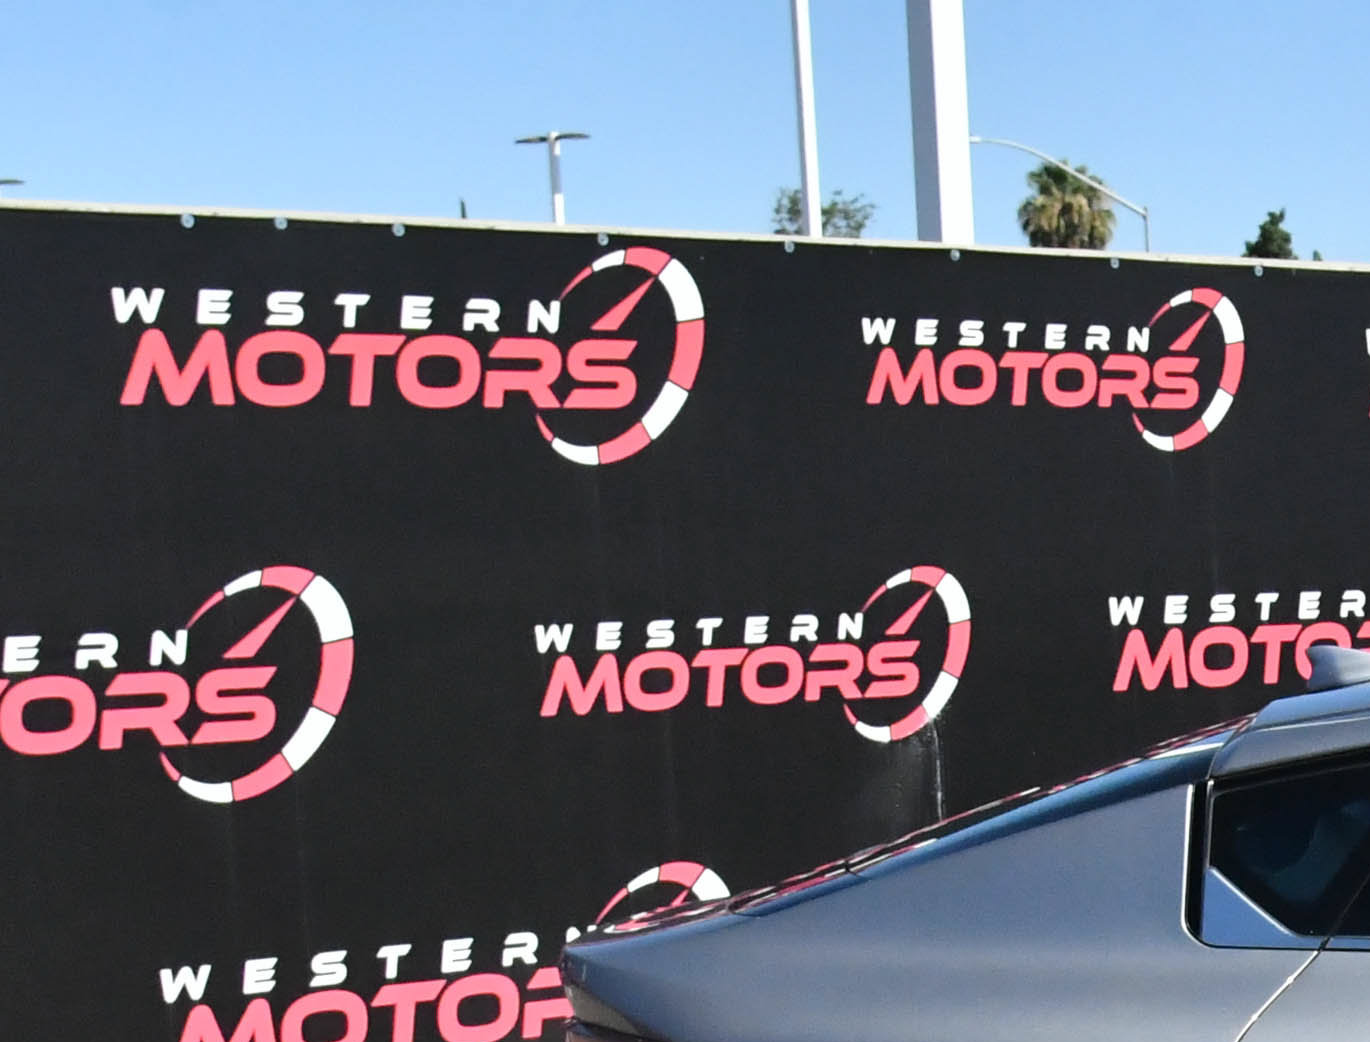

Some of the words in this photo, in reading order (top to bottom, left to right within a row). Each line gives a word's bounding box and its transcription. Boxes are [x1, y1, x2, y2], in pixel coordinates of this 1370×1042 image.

[111, 286, 561, 334] WESTERN
[861, 317, 1150, 353] WESTERN
[119, 327, 638, 410] MOTORS
[865, 346, 1201, 410] MOTORS
[534, 612, 864, 654] WESTERN
[0, 665, 278, 756] ORS
[539, 639, 921, 718] MOTORS
[159, 926, 598, 1004] WESTER
